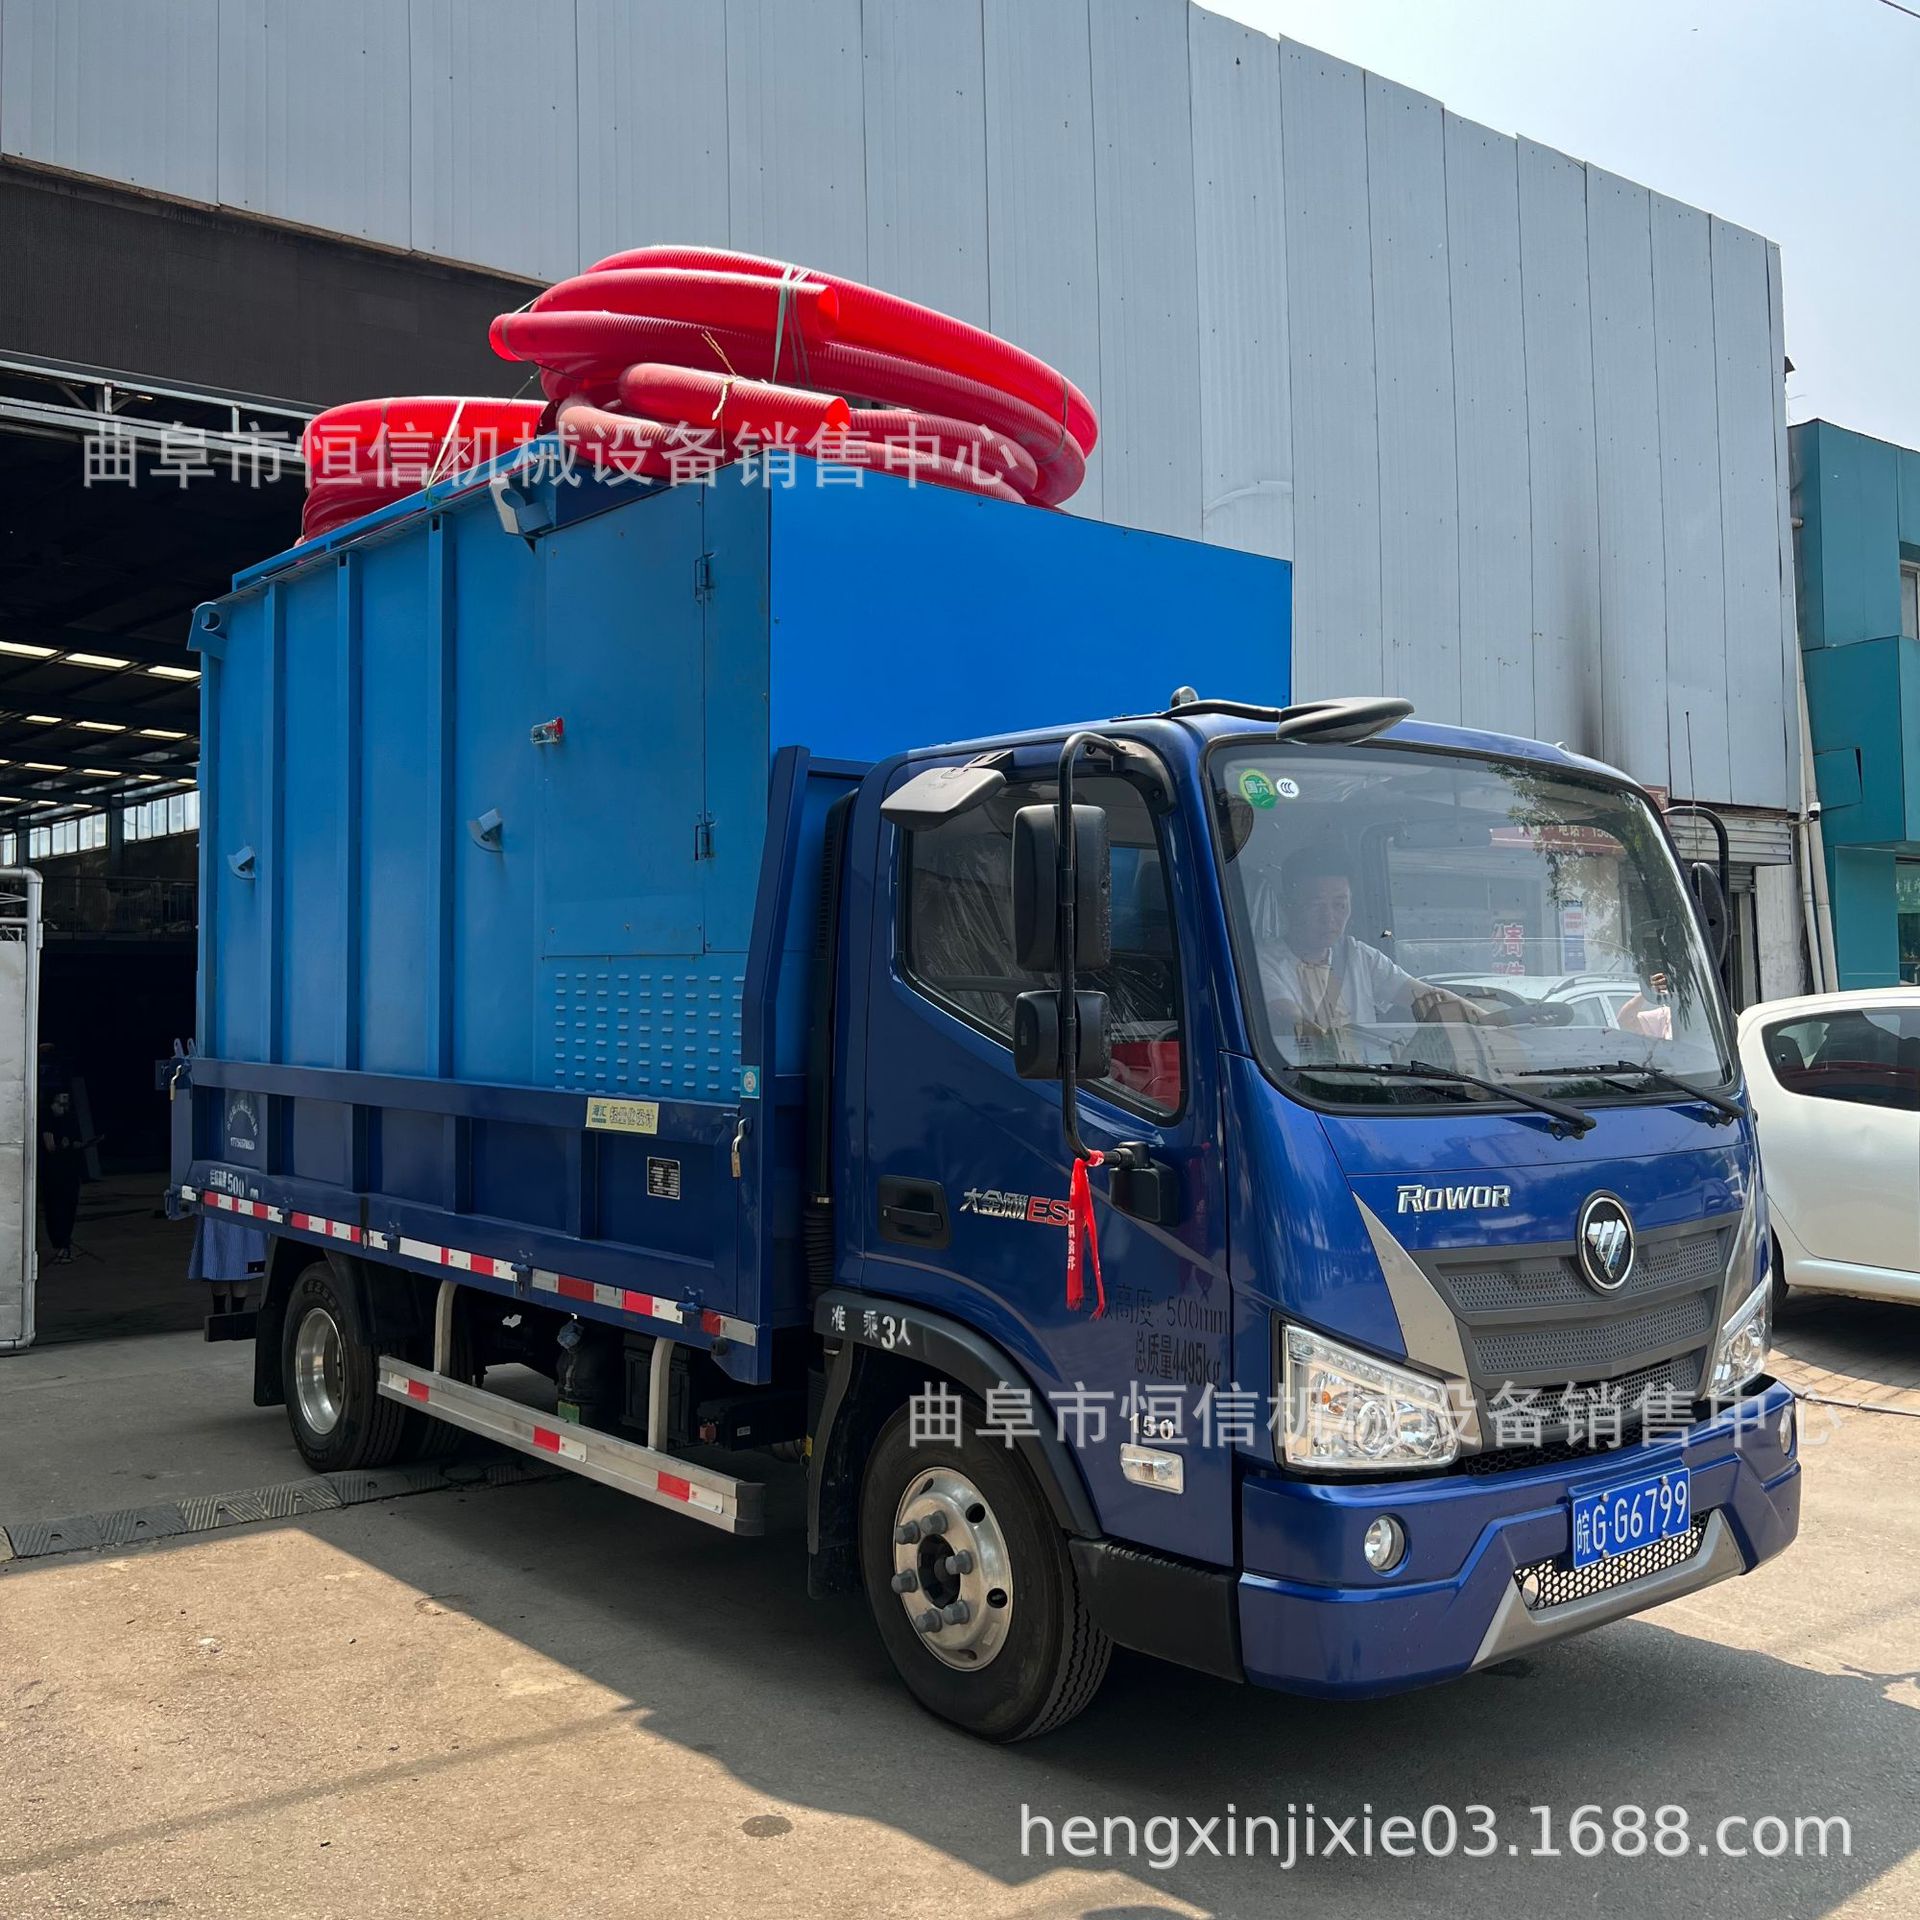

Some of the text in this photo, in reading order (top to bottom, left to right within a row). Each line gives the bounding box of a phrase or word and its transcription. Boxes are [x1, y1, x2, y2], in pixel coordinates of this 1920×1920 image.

[227, 1173, 245, 1198] 500
[1397, 1184, 1511, 1214] ROWOR
[1129, 1413, 1174, 1441] 150
